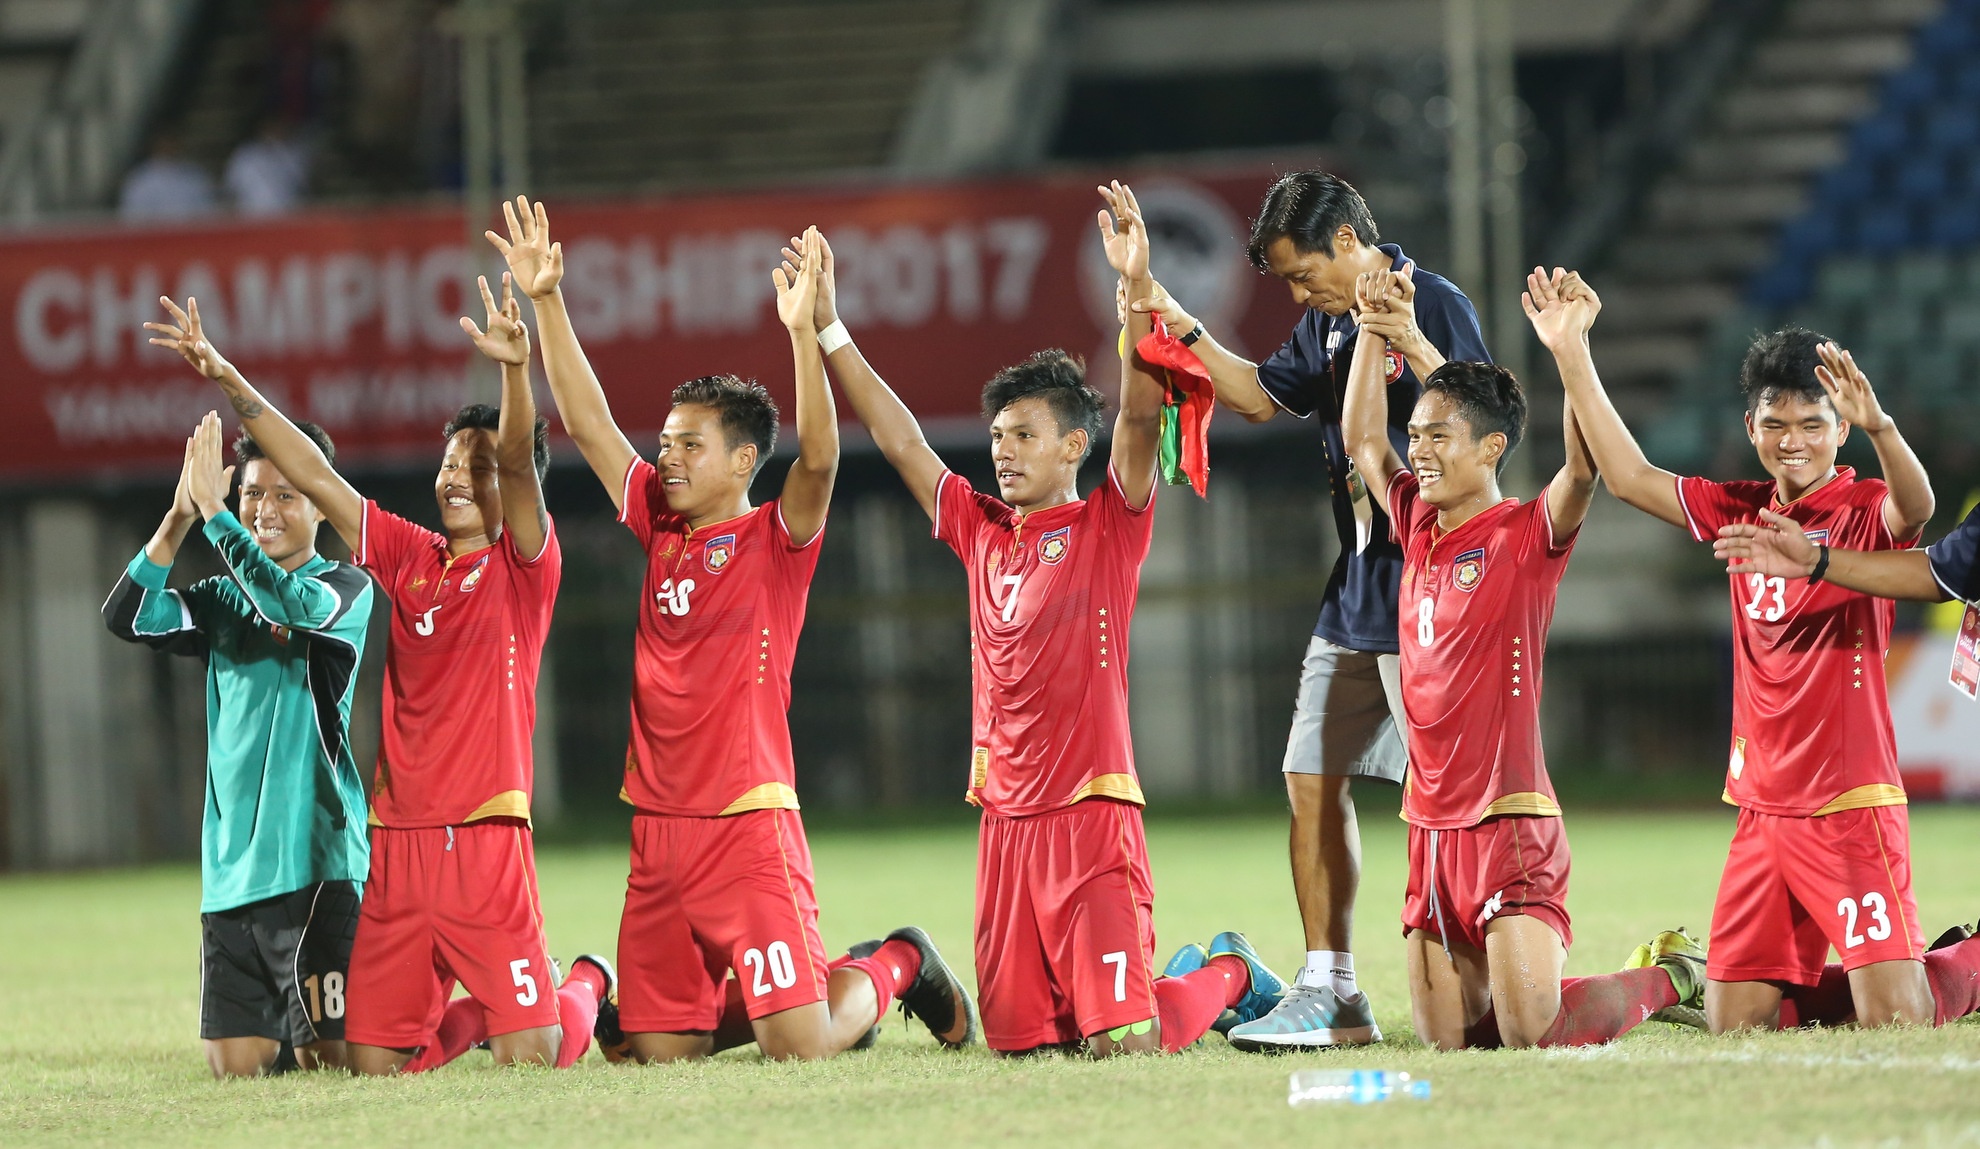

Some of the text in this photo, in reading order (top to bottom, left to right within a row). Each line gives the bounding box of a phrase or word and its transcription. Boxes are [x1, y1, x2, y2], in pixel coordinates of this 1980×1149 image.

[16, 216, 1048, 374] CHAMPIOSHIP 2017
[1002, 574, 1023, 622] 7
[1417, 597, 1435, 647] 8
[1745, 572, 1786, 622] 23
[1837, 891, 1892, 949] 23
[510, 958, 538, 1007] 5
[743, 940, 797, 998] 20
[1102, 950, 1128, 1002] 7
[304, 971, 345, 1022] 18
